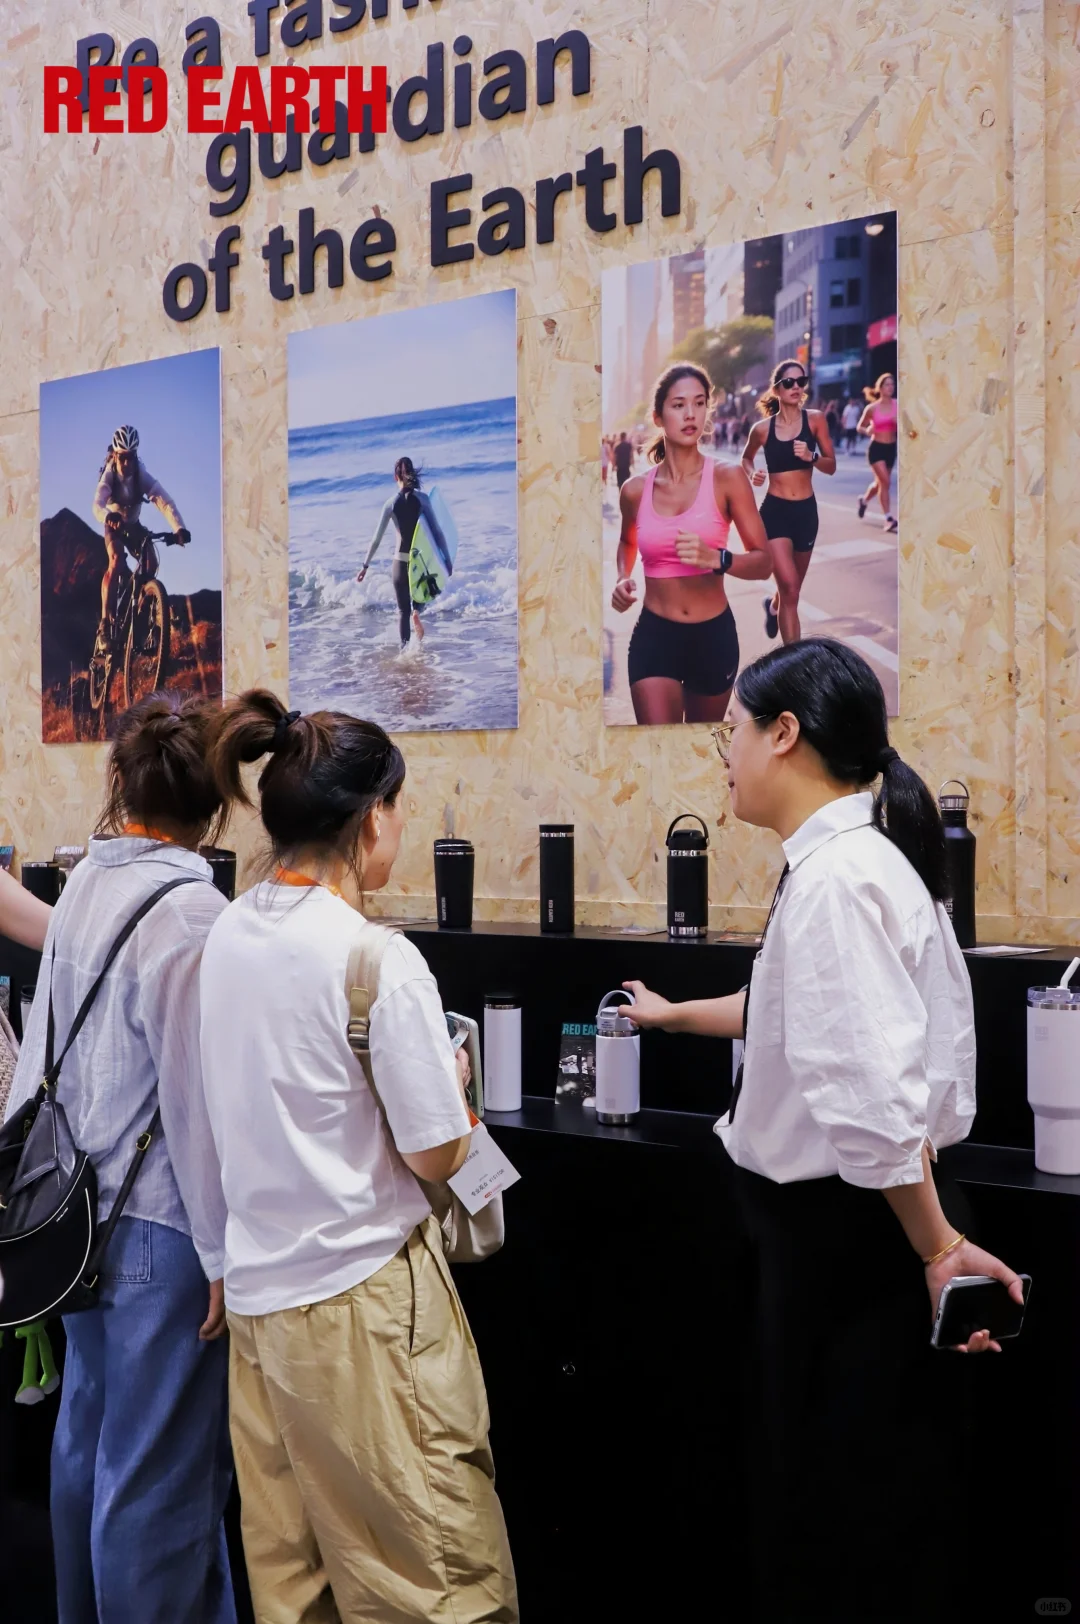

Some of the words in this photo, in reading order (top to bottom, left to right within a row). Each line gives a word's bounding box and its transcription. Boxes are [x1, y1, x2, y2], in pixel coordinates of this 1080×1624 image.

[182, 16, 222, 80] a
[206, 30, 591, 217] guardian
[163, 225, 241, 322] of
[262, 207, 396, 301] the
[430, 125, 681, 267] Earth
[562, 1023, 581, 1036] RED
